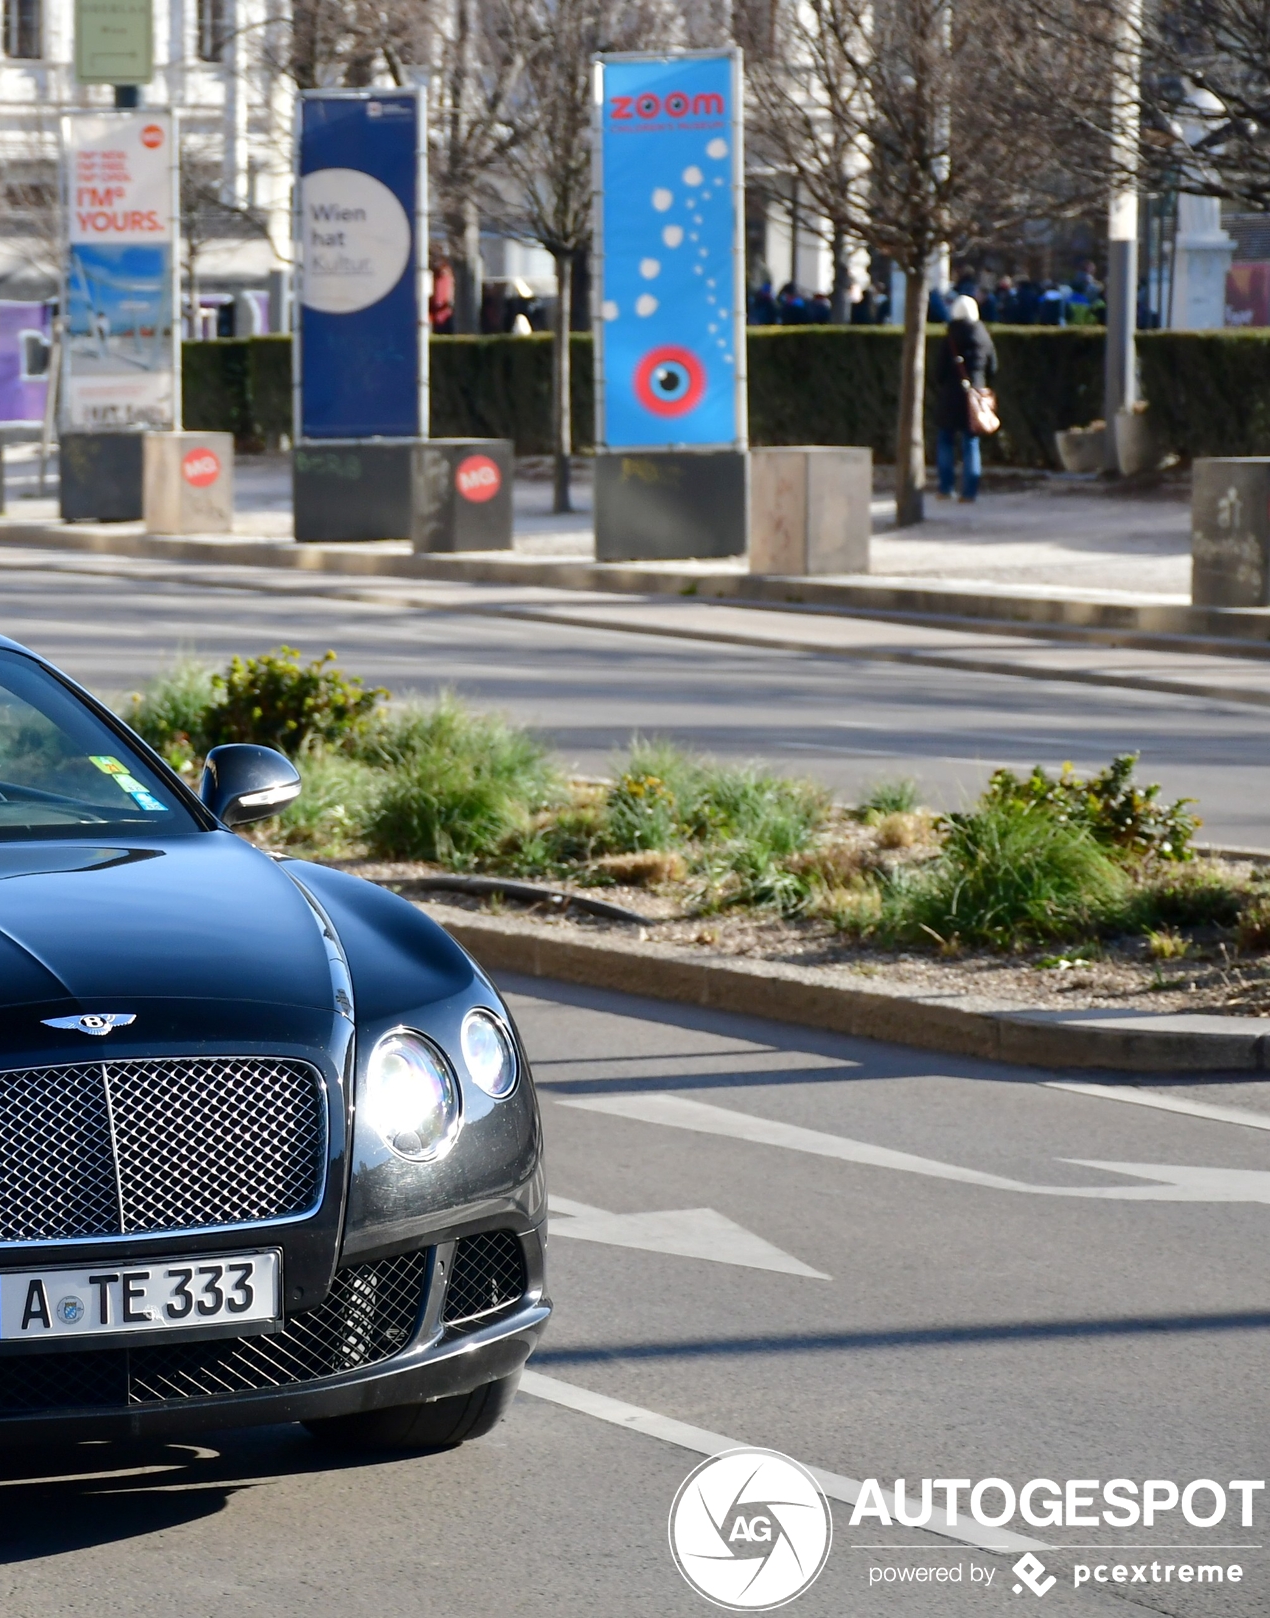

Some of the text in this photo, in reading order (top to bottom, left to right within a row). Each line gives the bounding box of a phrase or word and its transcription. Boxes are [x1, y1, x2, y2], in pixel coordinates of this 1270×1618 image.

[611, 89, 724, 119] zoom
[76, 211, 165, 232] YOURS.
[310, 203, 366, 223] Wien
[311, 229, 346, 247] hat
[184, 456, 218, 478] MQ
[459, 466, 498, 491] MQ
[21, 1279, 53, 1330] A
[89, 1271, 151, 1325] TE
[166, 1262, 255, 1319] 333
